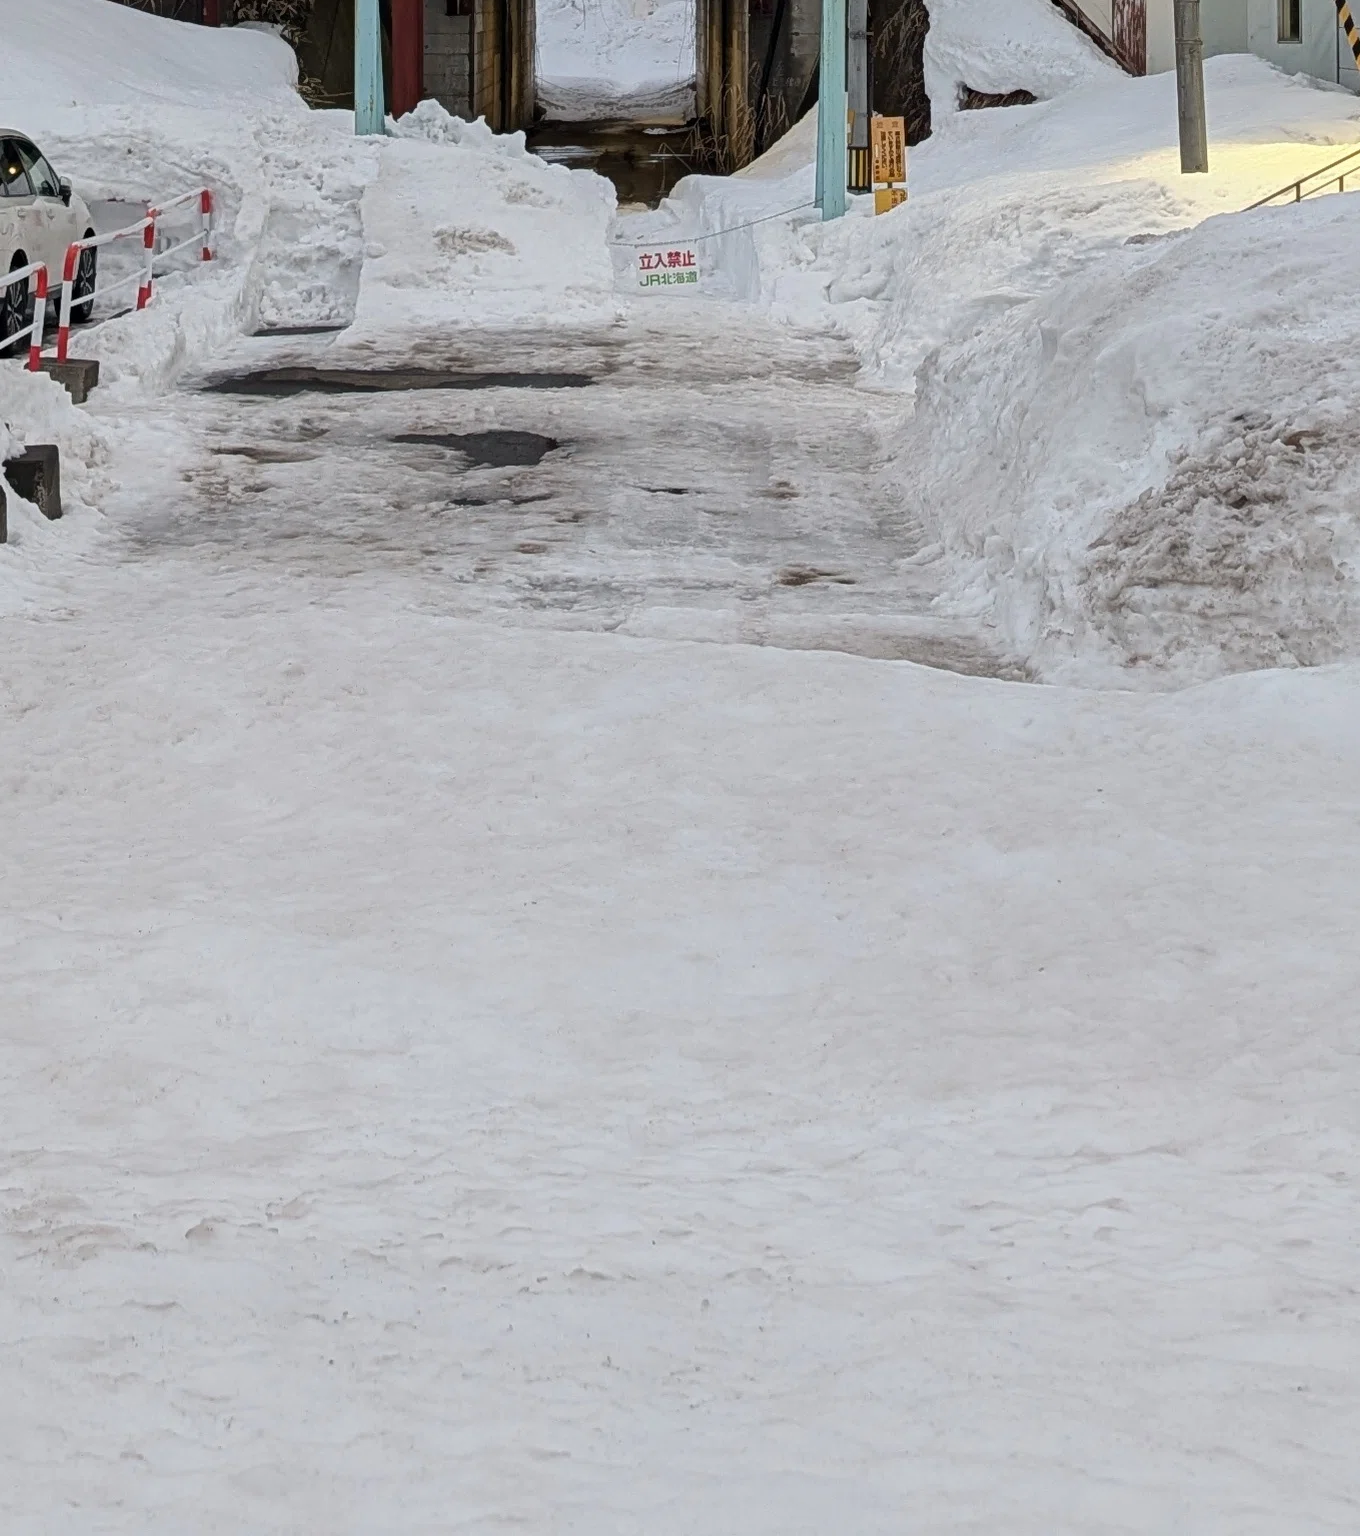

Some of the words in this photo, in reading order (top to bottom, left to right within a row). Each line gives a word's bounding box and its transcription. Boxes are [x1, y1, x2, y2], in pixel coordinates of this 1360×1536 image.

[639, 250, 696, 270] 立入禁止
[639, 271, 698, 287] JR北海道
